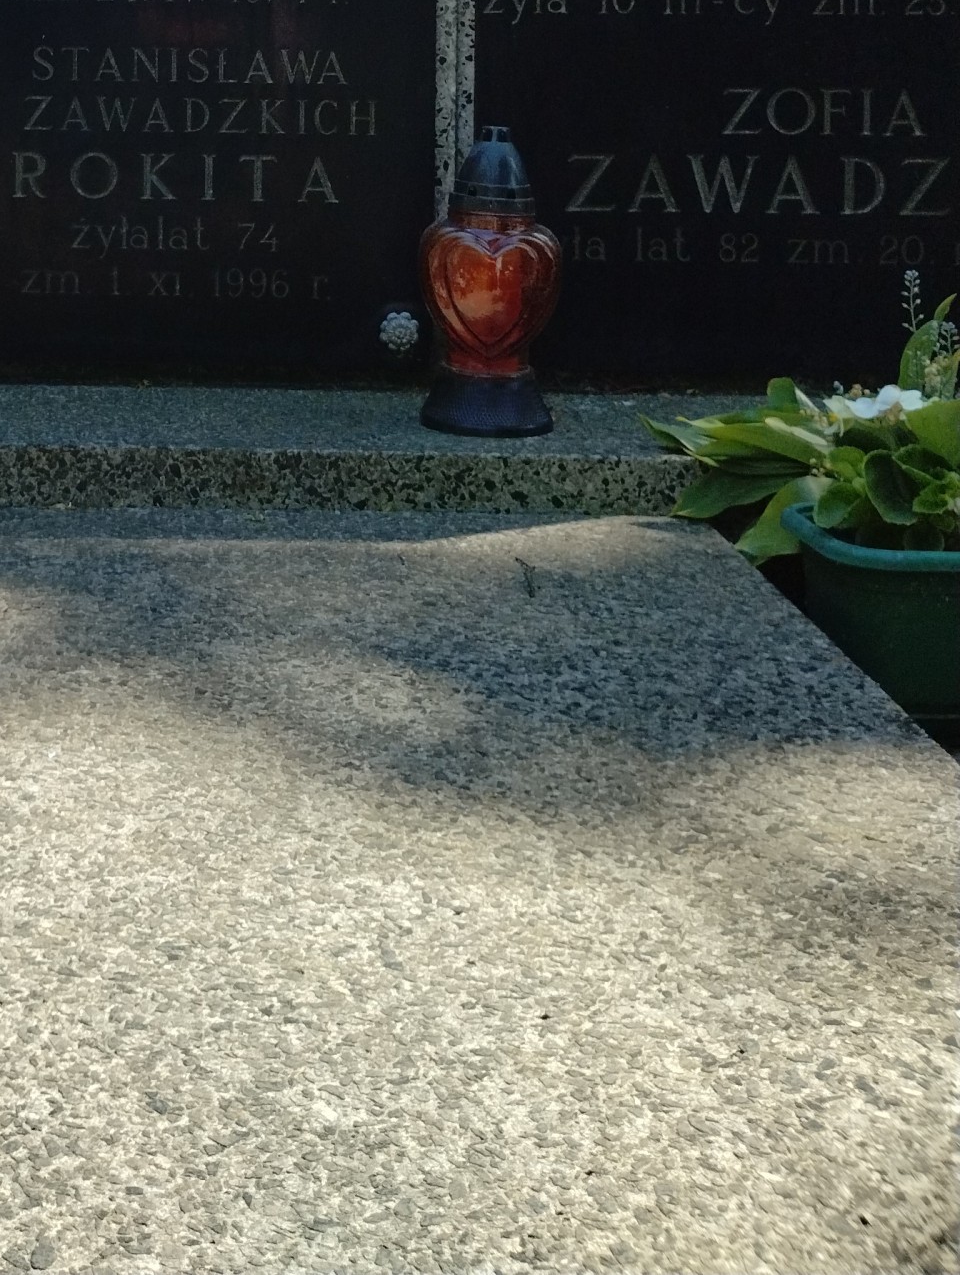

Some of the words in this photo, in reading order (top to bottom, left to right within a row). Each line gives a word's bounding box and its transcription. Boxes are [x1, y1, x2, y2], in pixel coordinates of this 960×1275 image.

[32, 46, 348, 85] STANISŁAWA
[23, 95, 377, 135] ZAWADZKICH
[722, 87, 927, 137] ZOFIA
[11, 151, 340, 203] ROKITA
[240, 224, 278, 252] 74
[638, 228, 690, 262] lat
[719, 234, 760, 263] 82
[214, 268, 290, 298] 1996
